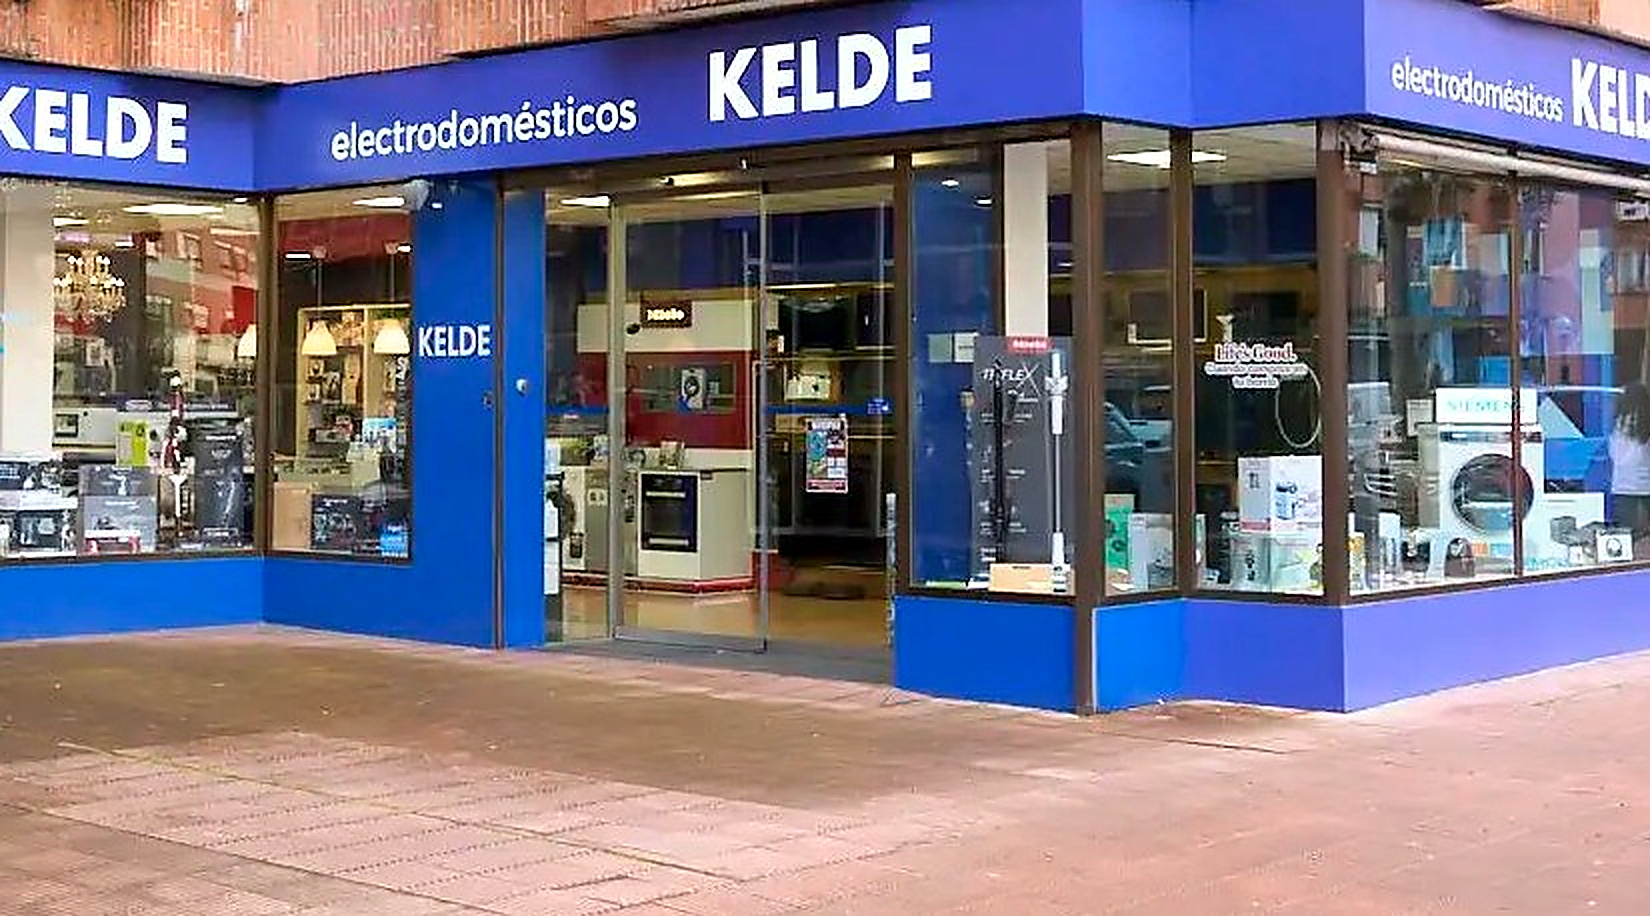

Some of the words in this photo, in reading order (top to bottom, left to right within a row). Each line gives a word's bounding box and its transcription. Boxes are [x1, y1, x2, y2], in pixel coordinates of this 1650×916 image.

[0, 86, 188, 164] KELDE
[331, 95, 638, 161] electrodomésticos
[708, 25, 933, 122] KELDE
[1391, 56, 1564, 122] electrodomésticos
[418, 325, 491, 357] KELDE
